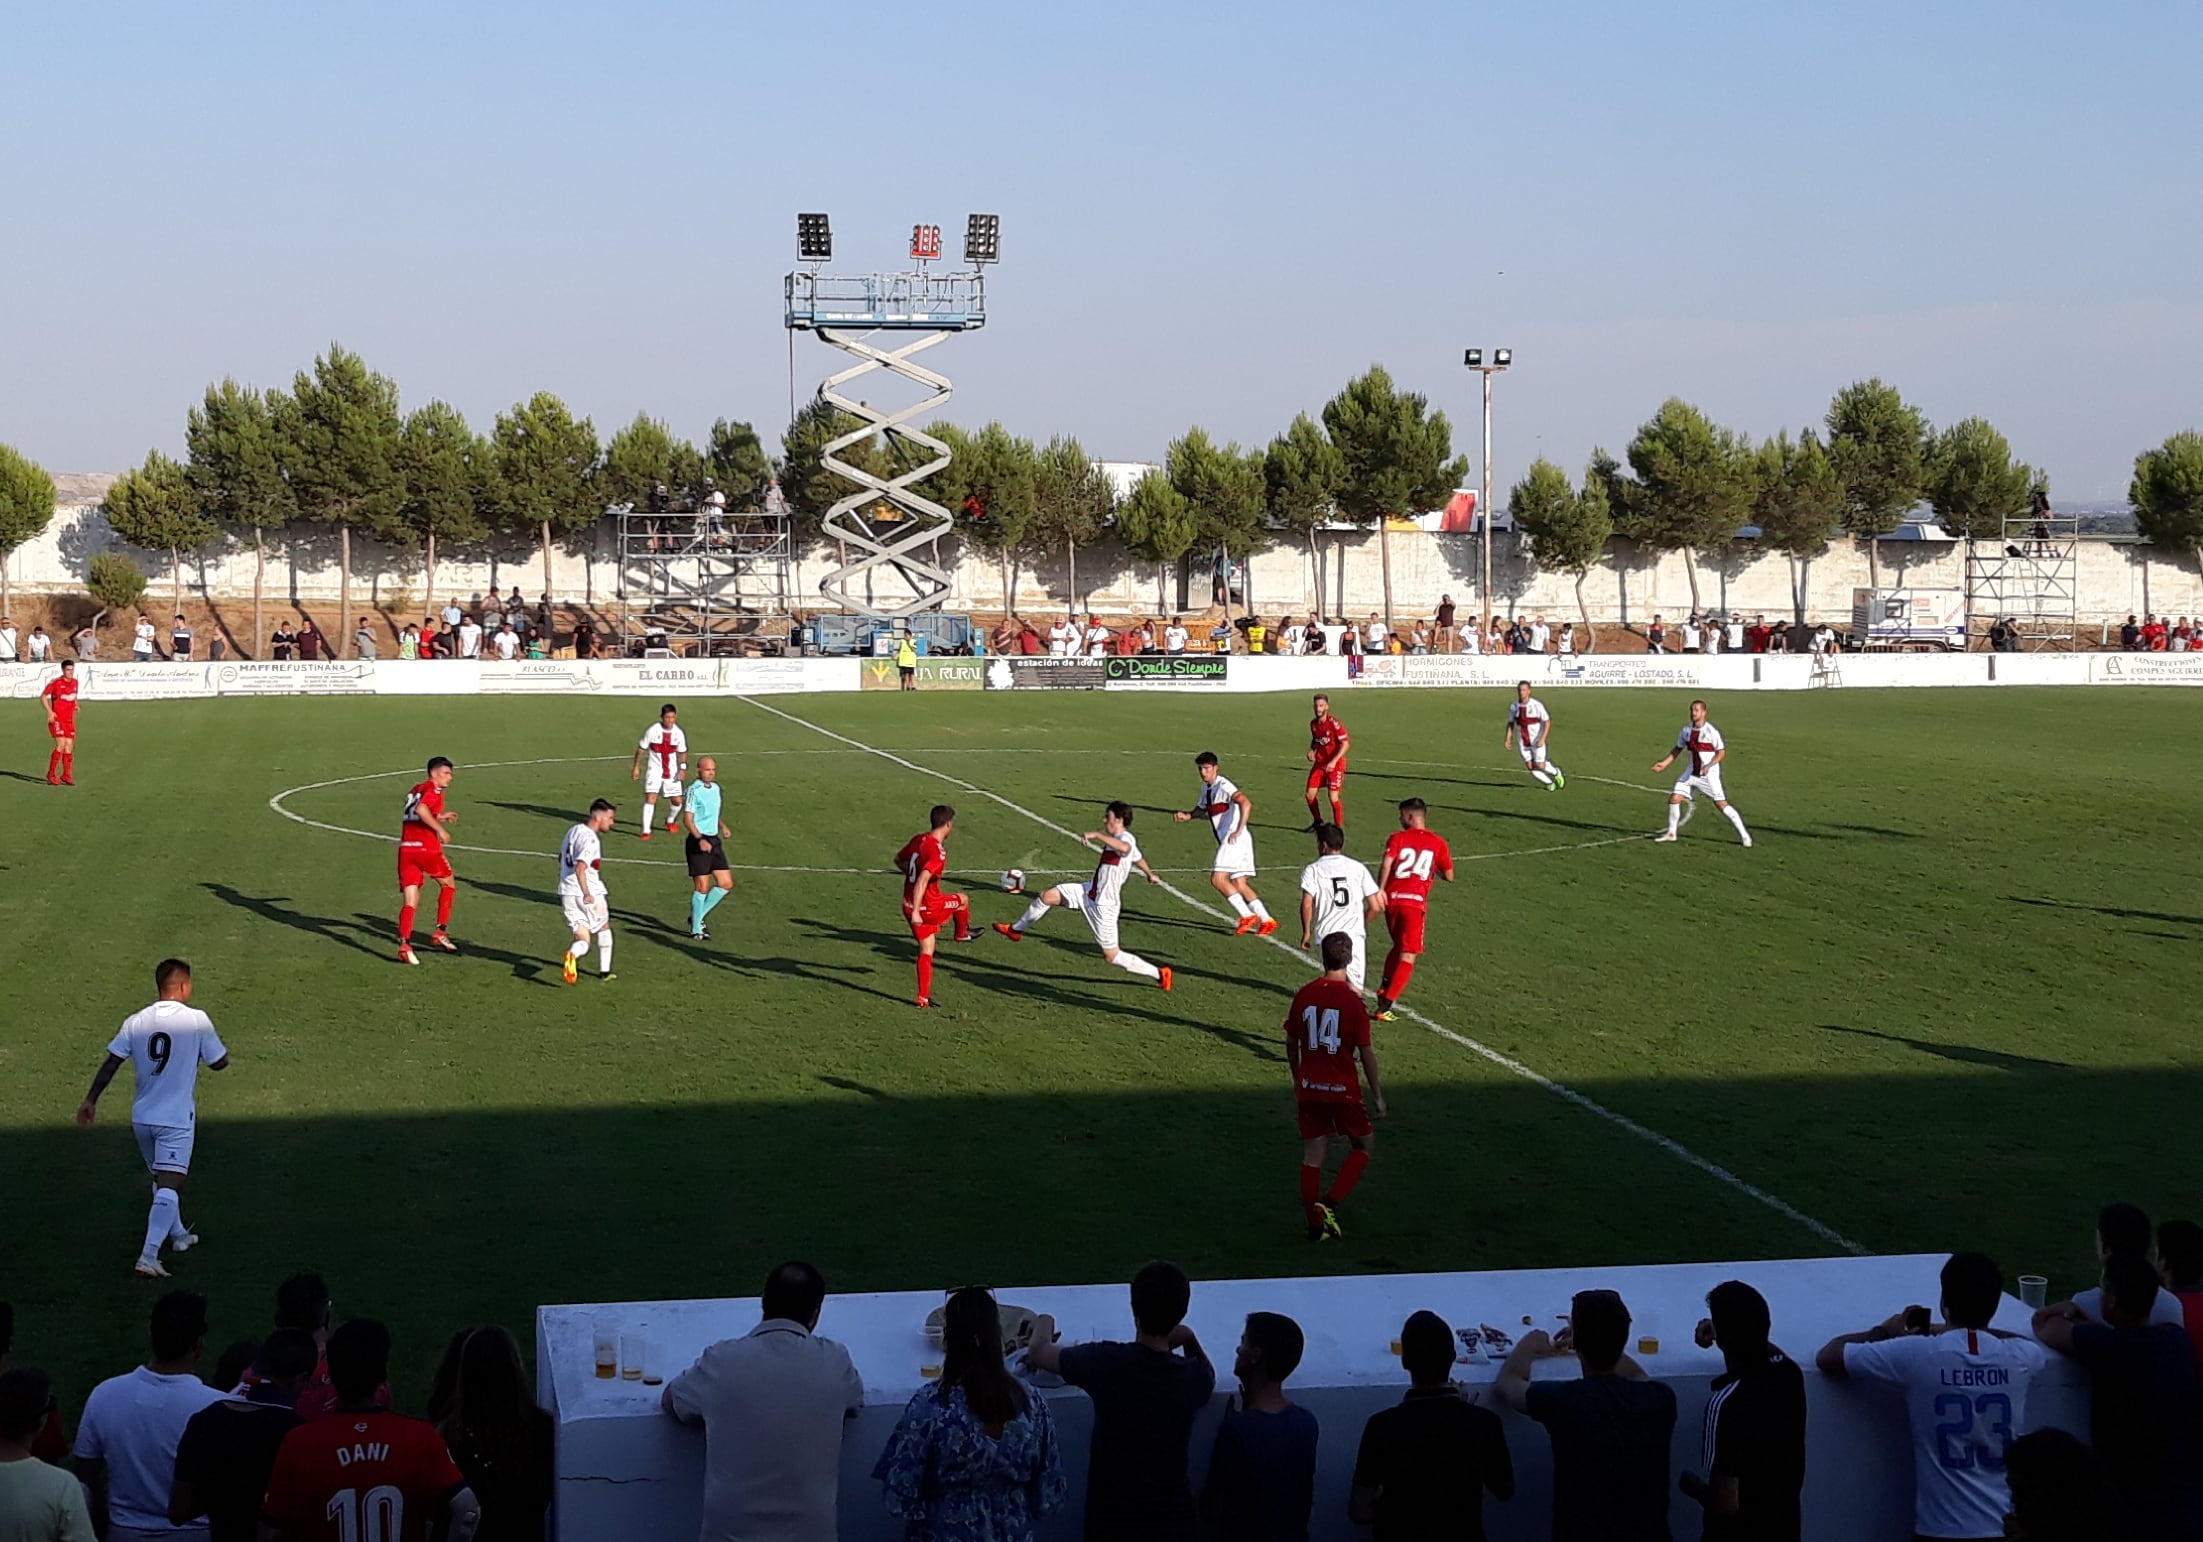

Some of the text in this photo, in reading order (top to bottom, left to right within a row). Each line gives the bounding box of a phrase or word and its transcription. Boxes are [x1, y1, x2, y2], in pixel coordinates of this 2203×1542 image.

[639, 670, 653, 680] EL
[656, 670, 694, 680] CARRO
[939, 667, 981, 680] RURAL
[1062, 658, 1075, 667] de
[1589, 670, 1627, 679] AGUIRRE
[1395, 847, 1435, 881] 24
[1330, 876, 1350, 908] 5
[1302, 1005, 1342, 1055] 14
[147, 1031, 172, 1076] 9
[1940, 1368, 2009, 1387] LEBRON
[1934, 1392, 2013, 1470] 23
[336, 1442, 390, 1467] DANI
[326, 1484, 404, 1542] 10
